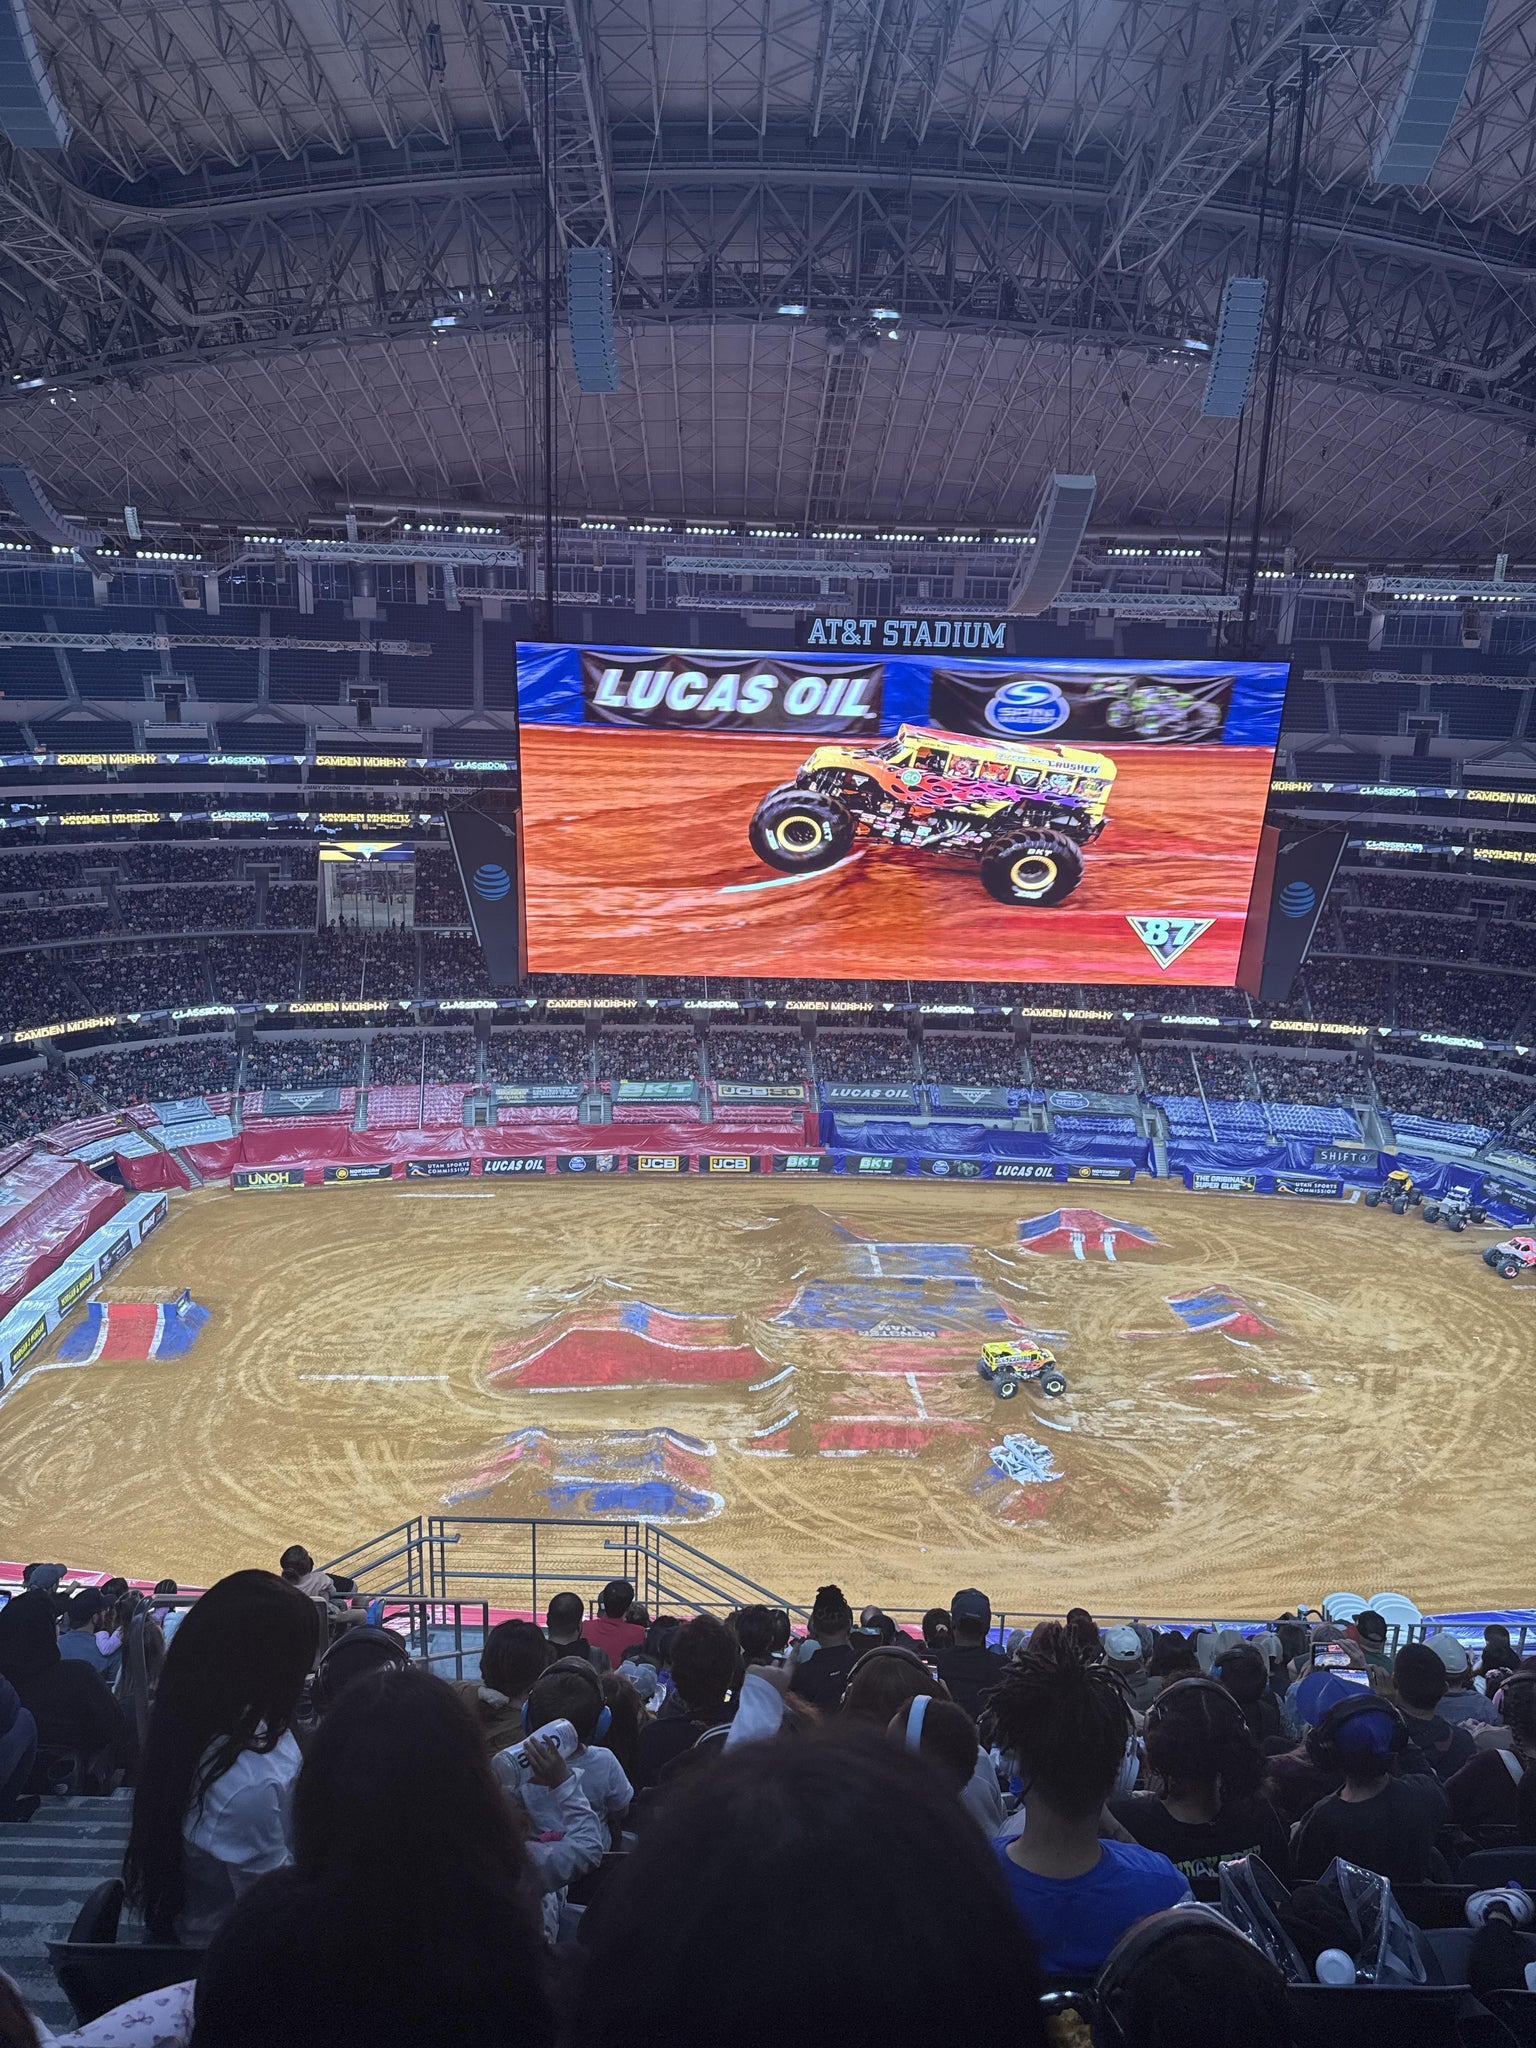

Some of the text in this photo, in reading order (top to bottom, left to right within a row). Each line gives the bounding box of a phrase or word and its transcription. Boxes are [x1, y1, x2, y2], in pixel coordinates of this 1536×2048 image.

[807, 618, 1007, 649] AT&T STADIUM
[592, 668, 778, 714] LUCAS
[904, 772, 919, 781] GO
[1144, 919, 1196, 946] 87
[831, 1088, 881, 1098] LUCAS
[788, 1157, 819, 1166] BKT
[1321, 1151, 1357, 1161] SHIFT
[484, 1160, 523, 1171] LUCAS
[642, 1157, 676, 1168] JCB
[713, 1158, 747, 1169] JCB
[861, 1159, 892, 1168] BKT
[995, 1165, 1034, 1177] LUCAS
[248, 1171, 289, 1185] UNOH
